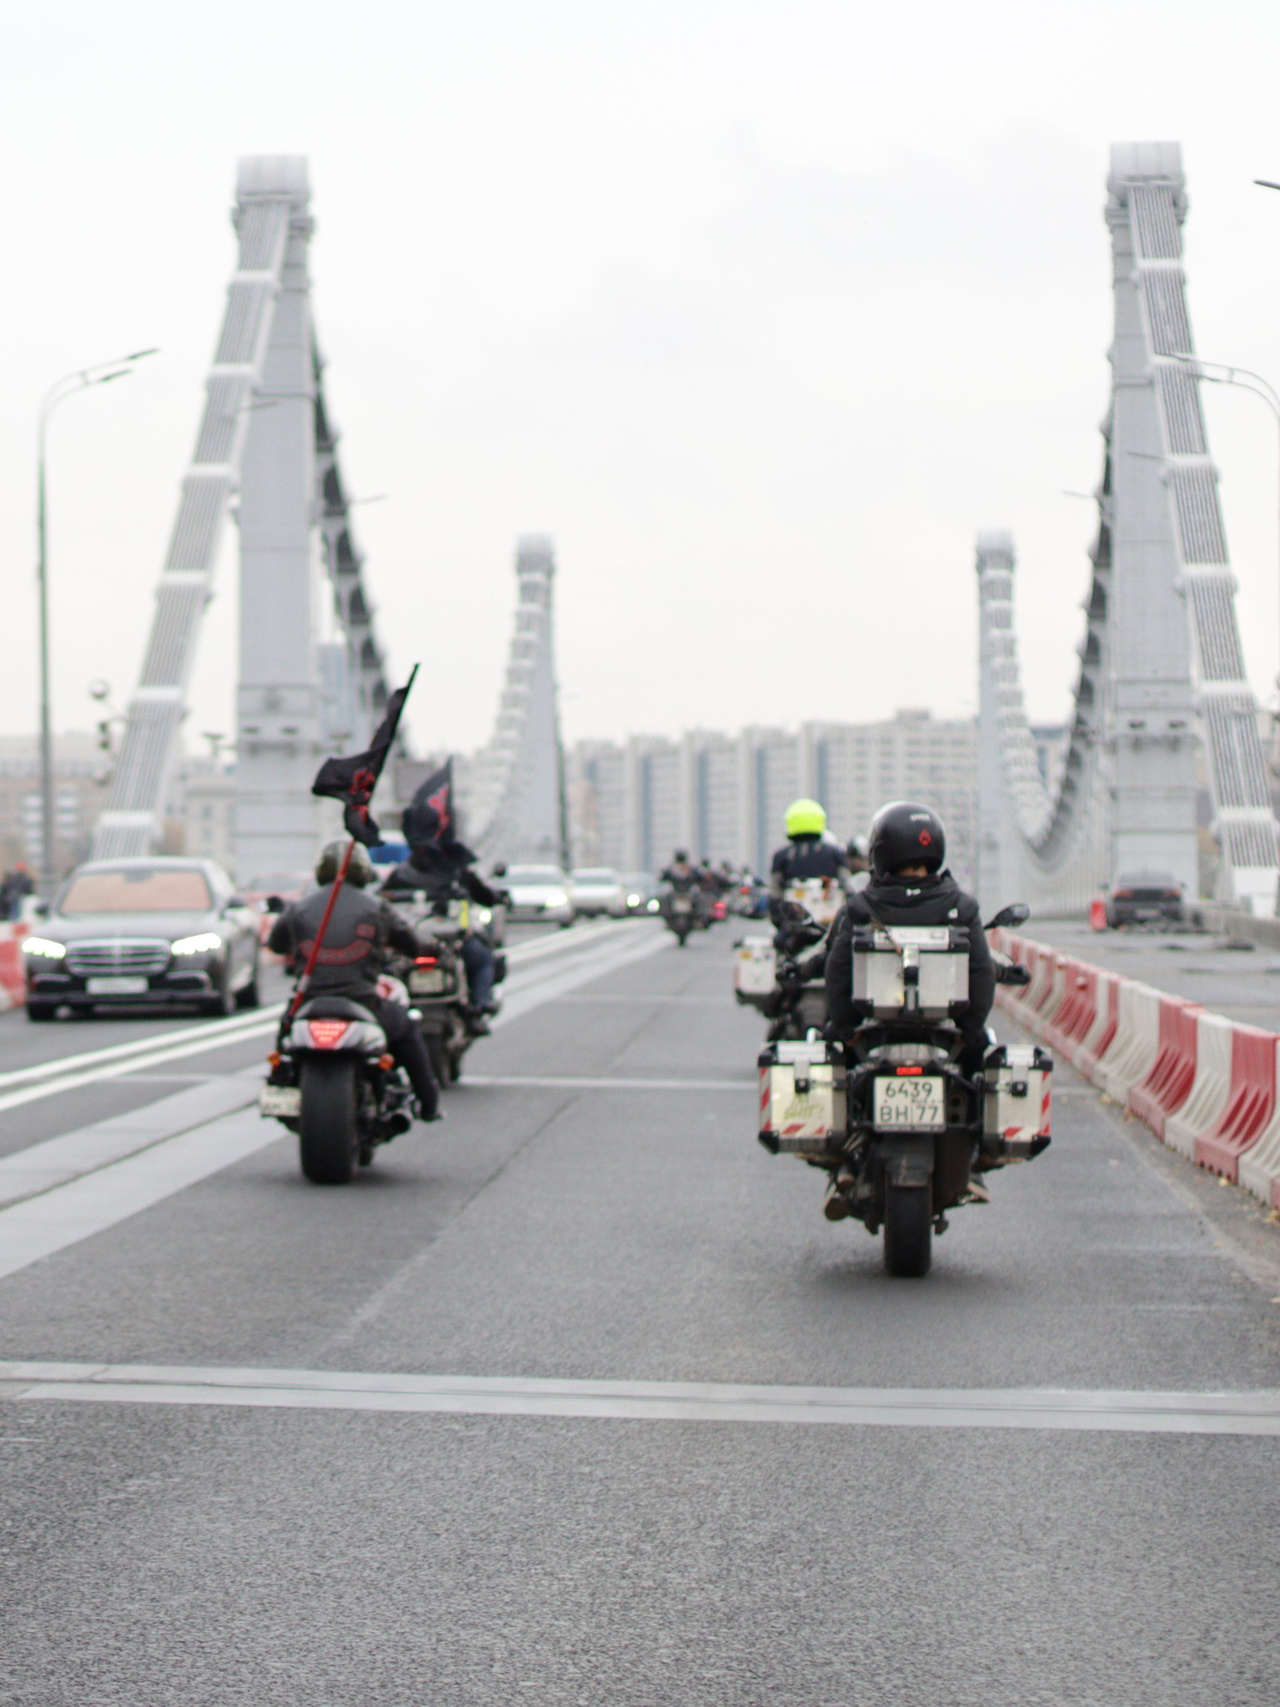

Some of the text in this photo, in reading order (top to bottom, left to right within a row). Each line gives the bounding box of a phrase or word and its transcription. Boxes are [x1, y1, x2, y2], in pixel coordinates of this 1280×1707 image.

[886, 1082, 933, 1099] 6439
[880, 1105, 939, 1121] BH 77
